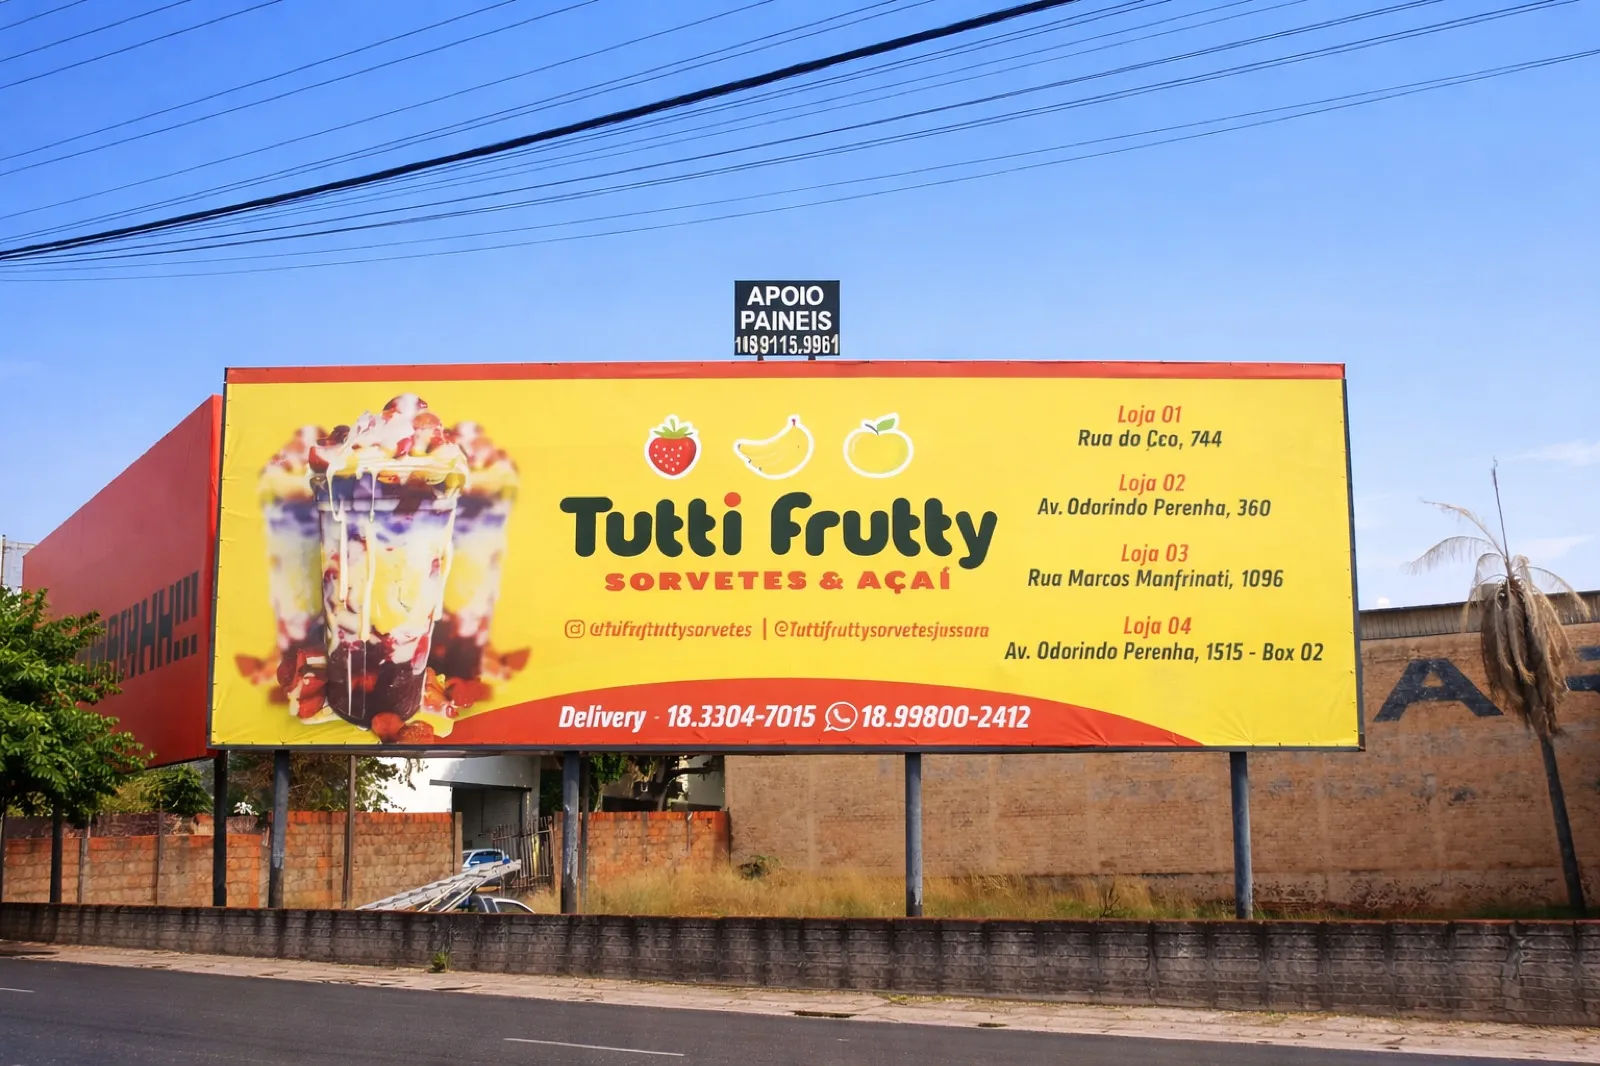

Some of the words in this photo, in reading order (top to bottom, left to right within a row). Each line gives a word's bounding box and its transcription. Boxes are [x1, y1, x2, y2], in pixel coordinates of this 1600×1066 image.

[746, 285, 825, 307] APOIO
[740, 310, 833, 331] PAINEIS
[1117, 405, 1156, 427] Loja
[1161, 405, 1182, 424] 01
[1077, 429, 1113, 447] Rua
[1118, 429, 1141, 447] do
[1190, 430, 1223, 448] 744
[1118, 473, 1157, 496] Loja
[1162, 473, 1186, 492] 02
[1037, 497, 1063, 516] Av.
[1153, 498, 1231, 519] Perenha,
[1237, 498, 1272, 517] 360
[559, 491, 743, 557] Tutti
[1121, 543, 1159, 567] Loja
[1165, 543, 1189, 563] 03
[604, 570, 807, 592] SORVETES
[818, 571, 844, 591] &
[856, 567, 950, 595] AÇAÍ
[1027, 568, 1063, 587] Rua
[1067, 569, 1130, 587] Marcos
[1135, 568, 1234, 592] Manfrinati,
[1241, 569, 1284, 588] 1096
[1123, 615, 1162, 640] Loja
[1167, 616, 1192, 635] 04
[1003, 641, 1031, 660] Av.
[1123, 641, 1200, 664] Perenha,
[1206, 642, 1244, 661] 1515
[1261, 642, 1295, 662] Box
[1300, 642, 1324, 662] 02
[558, 704, 647, 733] Delivery
[667, 703, 817, 728] 18.3304-7015
[862, 704, 1031, 729] 18.99800-2412
